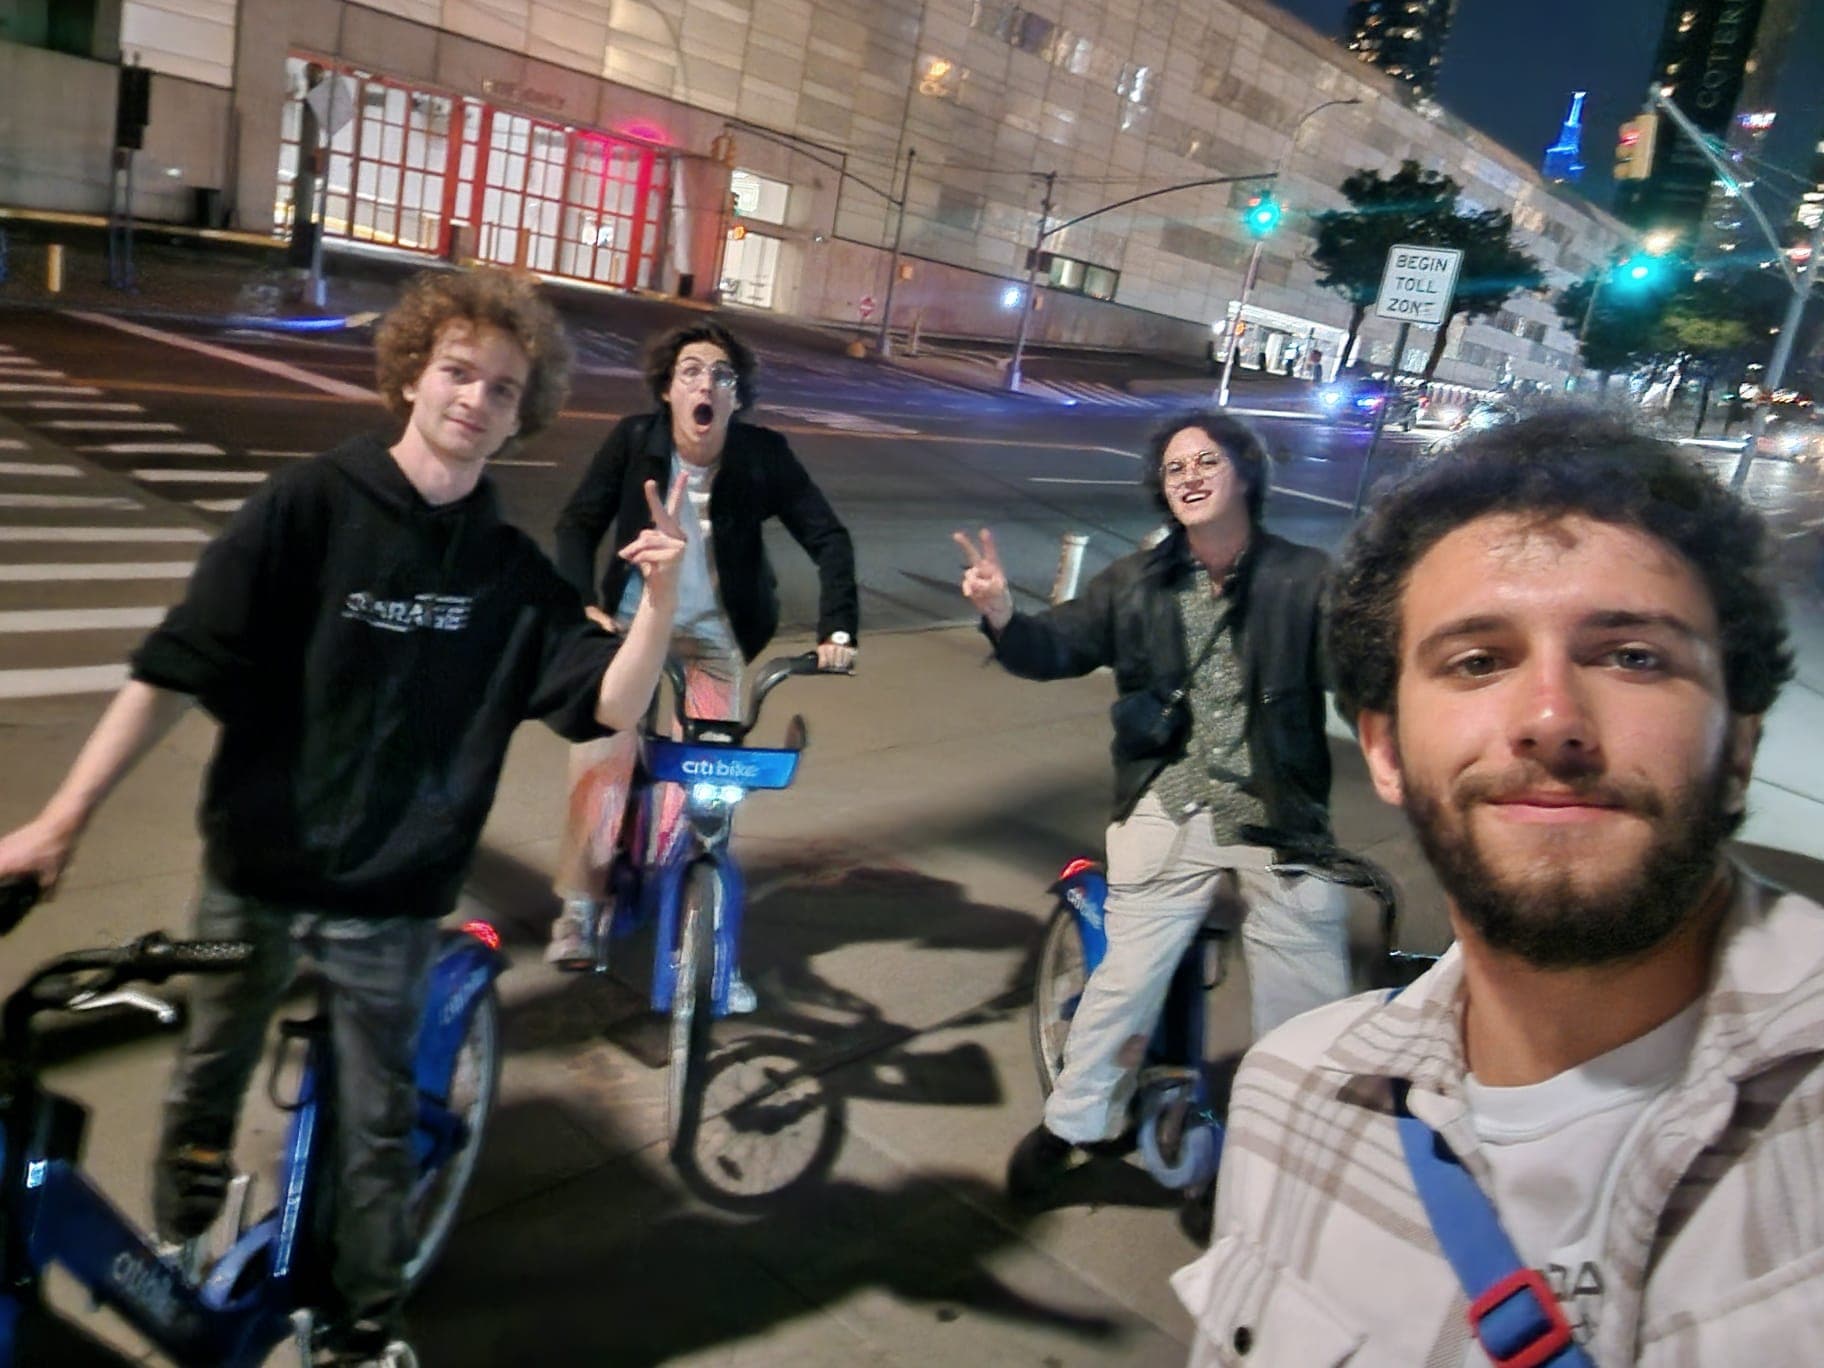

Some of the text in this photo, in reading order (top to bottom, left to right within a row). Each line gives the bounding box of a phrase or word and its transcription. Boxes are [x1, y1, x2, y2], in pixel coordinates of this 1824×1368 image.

[1395, 254, 1448, 272] BEGIN
[1395, 276, 1437, 294] TOLL
[1386, 298, 1436, 315] ZONE
[681, 759, 761, 777] citi bike
